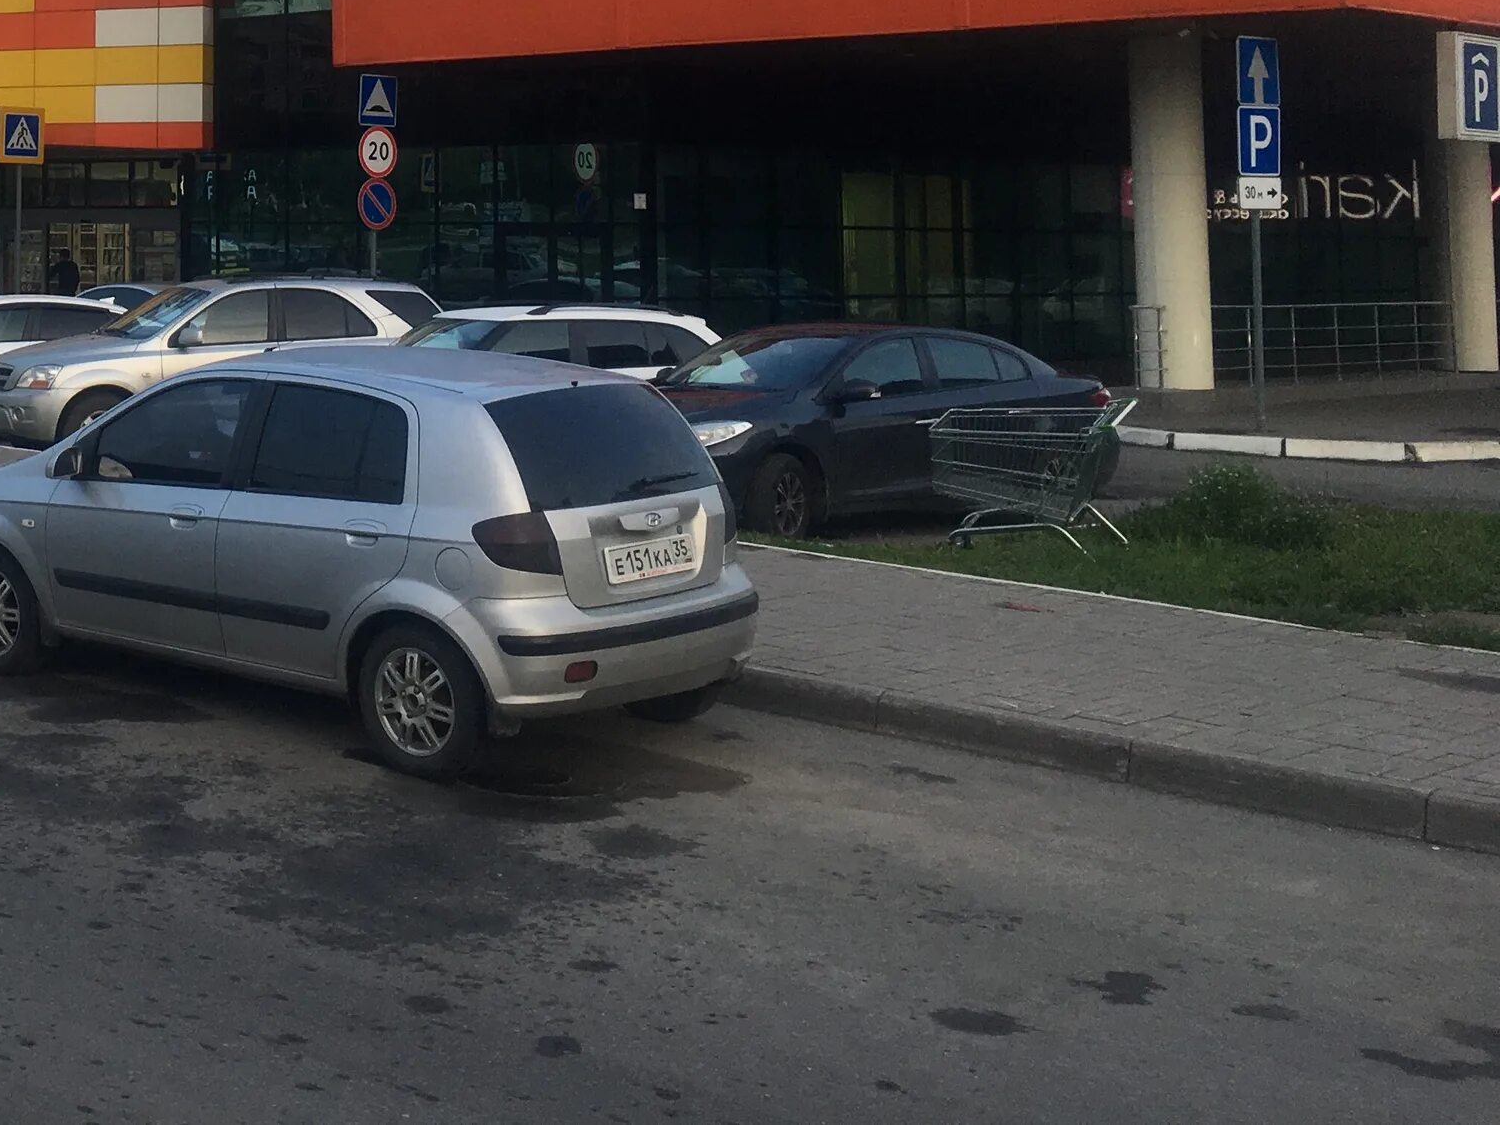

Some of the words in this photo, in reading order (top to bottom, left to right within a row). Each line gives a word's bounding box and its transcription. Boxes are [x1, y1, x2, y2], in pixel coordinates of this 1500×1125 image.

[1474, 68, 1489, 123] P
[368, 141, 389, 161] 20
[1249, 115, 1273, 168] P
